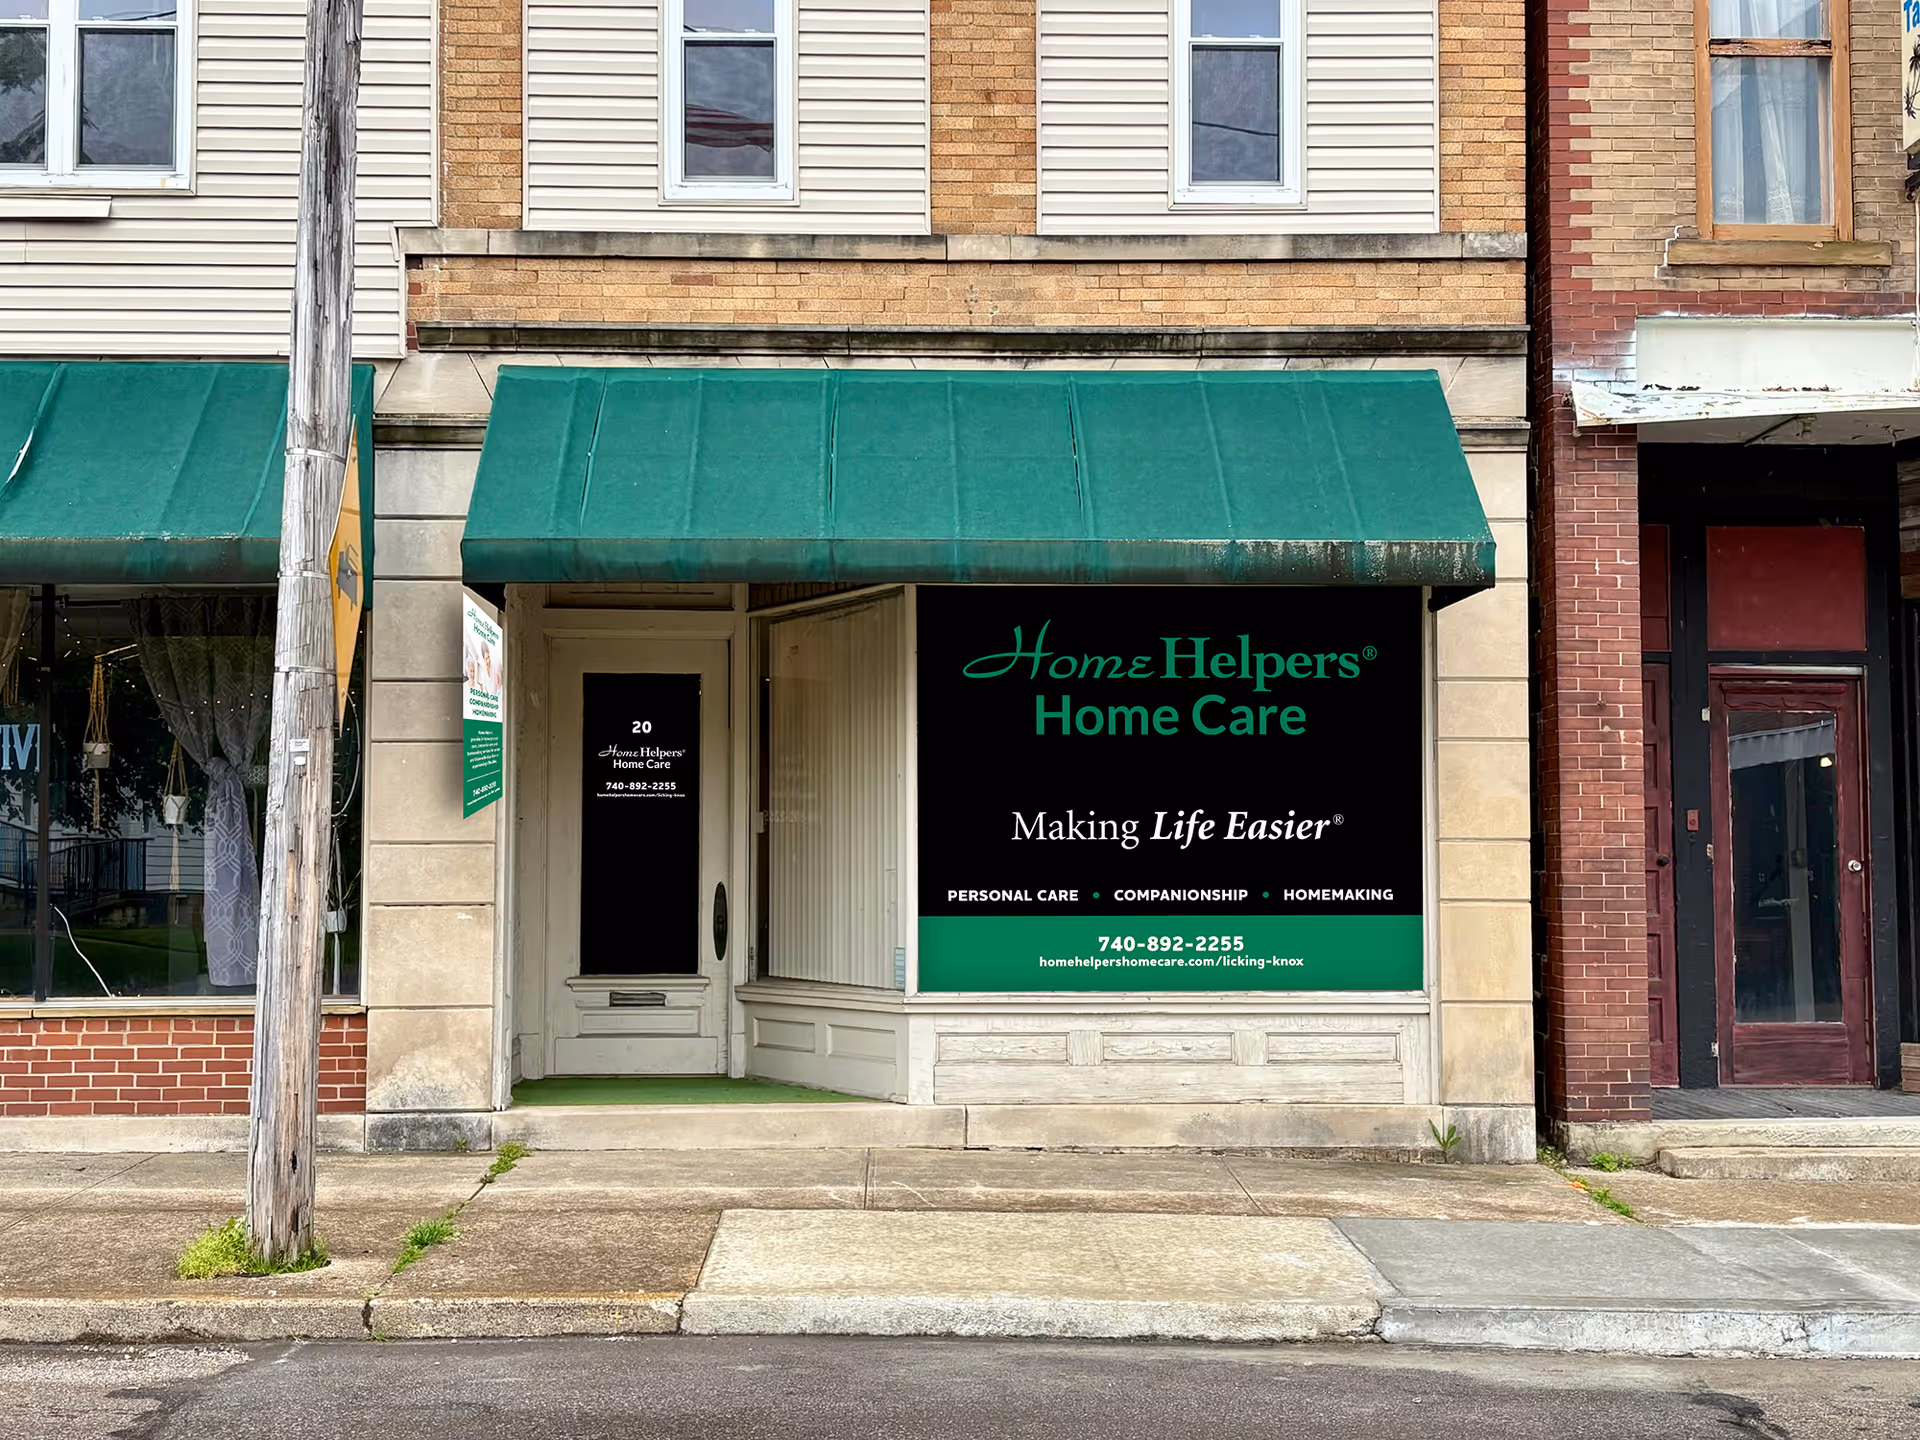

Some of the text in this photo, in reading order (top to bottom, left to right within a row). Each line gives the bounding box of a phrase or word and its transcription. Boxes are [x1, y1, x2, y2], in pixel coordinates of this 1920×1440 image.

[963, 619, 1154, 679] Home
[1036, 694, 1307, 736] Home Care
[631, 720, 652, 734] 20
[597, 744, 639, 758] Home
[613, 759, 671, 769] Home Care
[605, 781, 677, 791] 740-892-2255
[1012, 809, 1140, 850] Making
[1150, 809, 1215, 850] Life
[947, 888, 1394, 902] PERSONAL CARE COMPANIONSHIP HOMEMAKING
[1098, 935, 1244, 952] 740-892-2255
[1039, 954, 1304, 970] homehelpershomecare.com/licking-knox
